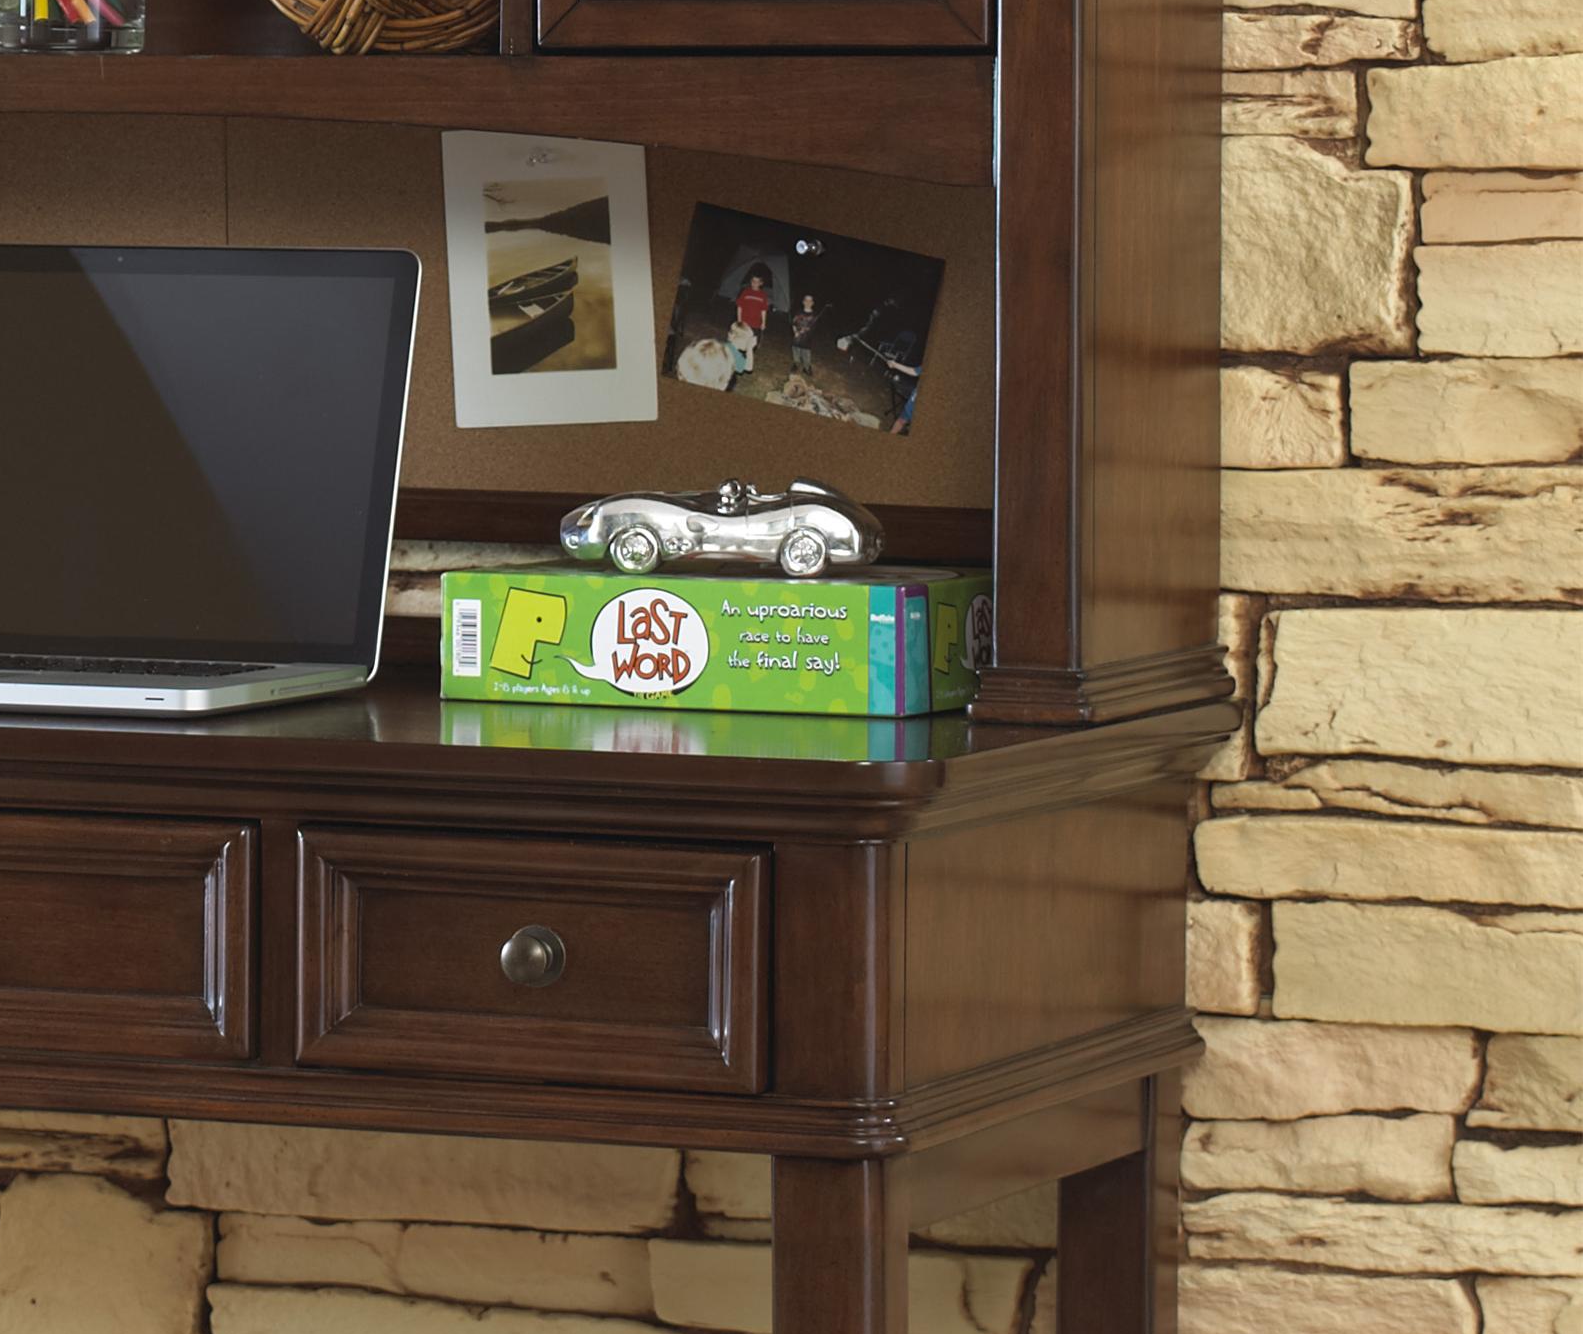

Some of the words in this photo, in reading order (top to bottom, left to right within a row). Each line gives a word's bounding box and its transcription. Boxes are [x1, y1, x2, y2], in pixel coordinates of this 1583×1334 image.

[721, 599, 741, 616] An
[747, 603, 847, 622] uproarious
[739, 631, 769, 643] race
[776, 630, 791, 643] to
[797, 626, 830, 644] have
[611, 643, 691, 685] WORD
[728, 649, 751, 668] the
[757, 650, 798, 669] final
[806, 651, 841, 675] say!
[580, 687, 591, 697] up
